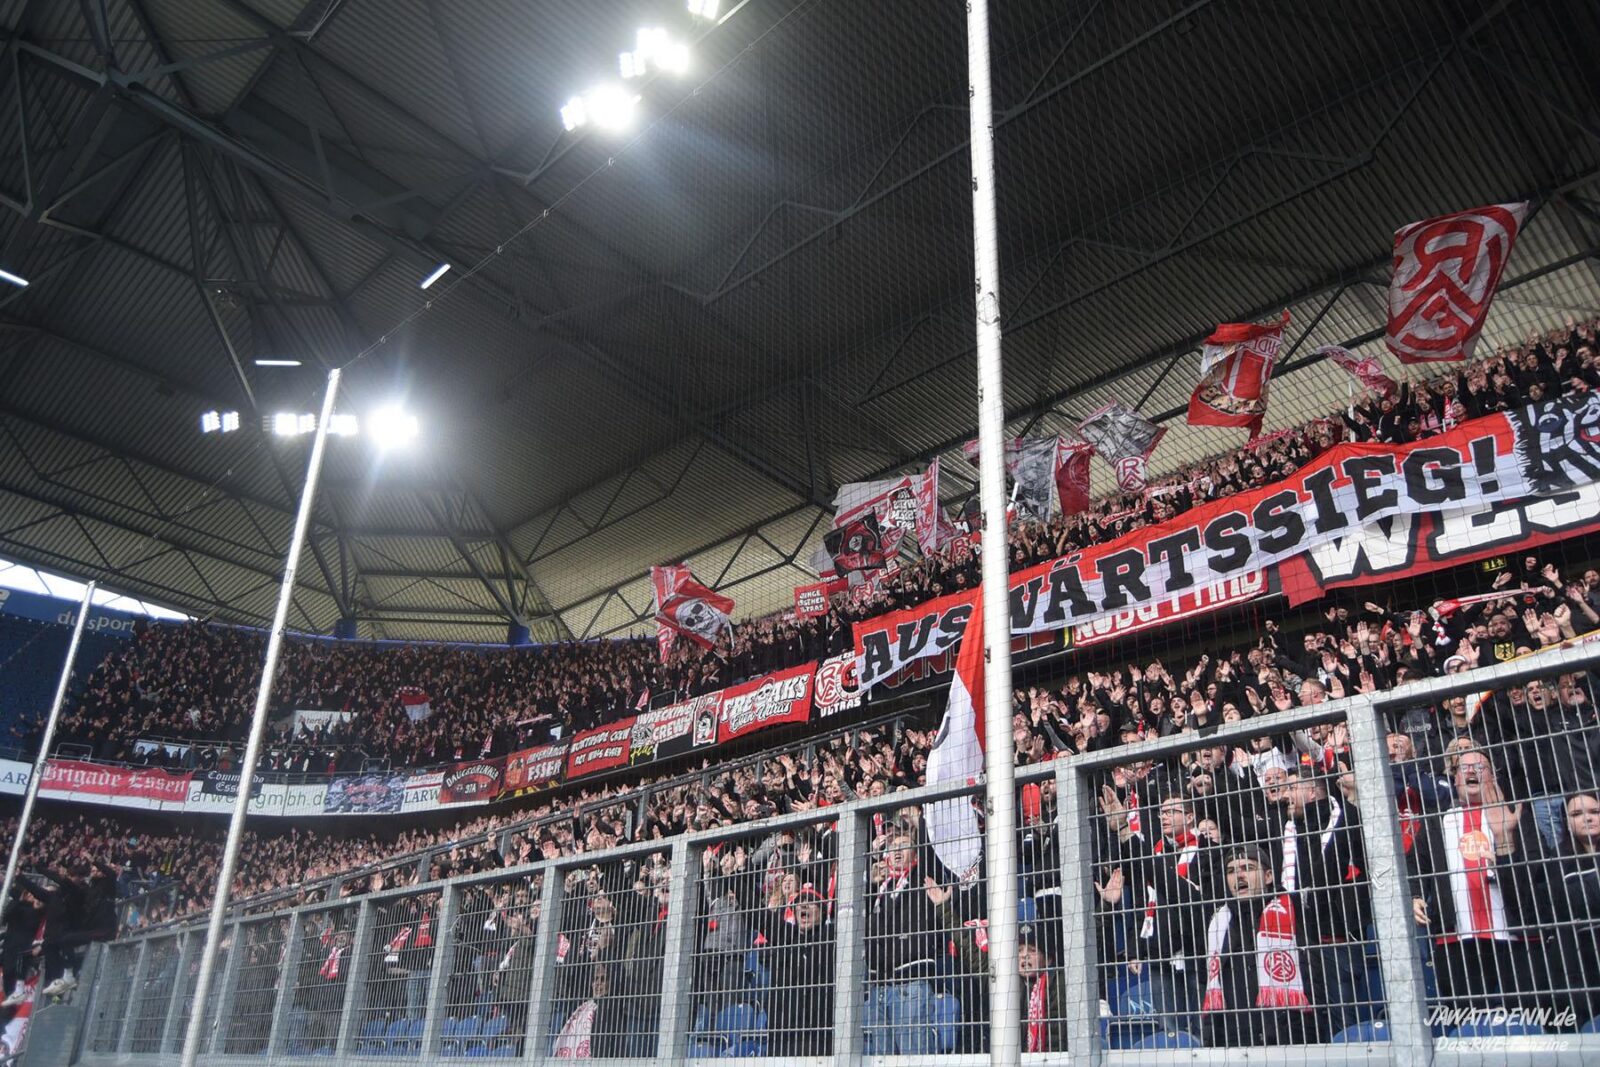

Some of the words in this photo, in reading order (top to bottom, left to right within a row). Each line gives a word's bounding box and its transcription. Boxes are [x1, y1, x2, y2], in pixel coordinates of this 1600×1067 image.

[820, 697, 862, 718] ULTRAS
[0, 770, 28, 786] AR
[42, 763, 122, 788] Brigade
[129, 772, 187, 793] Essen
